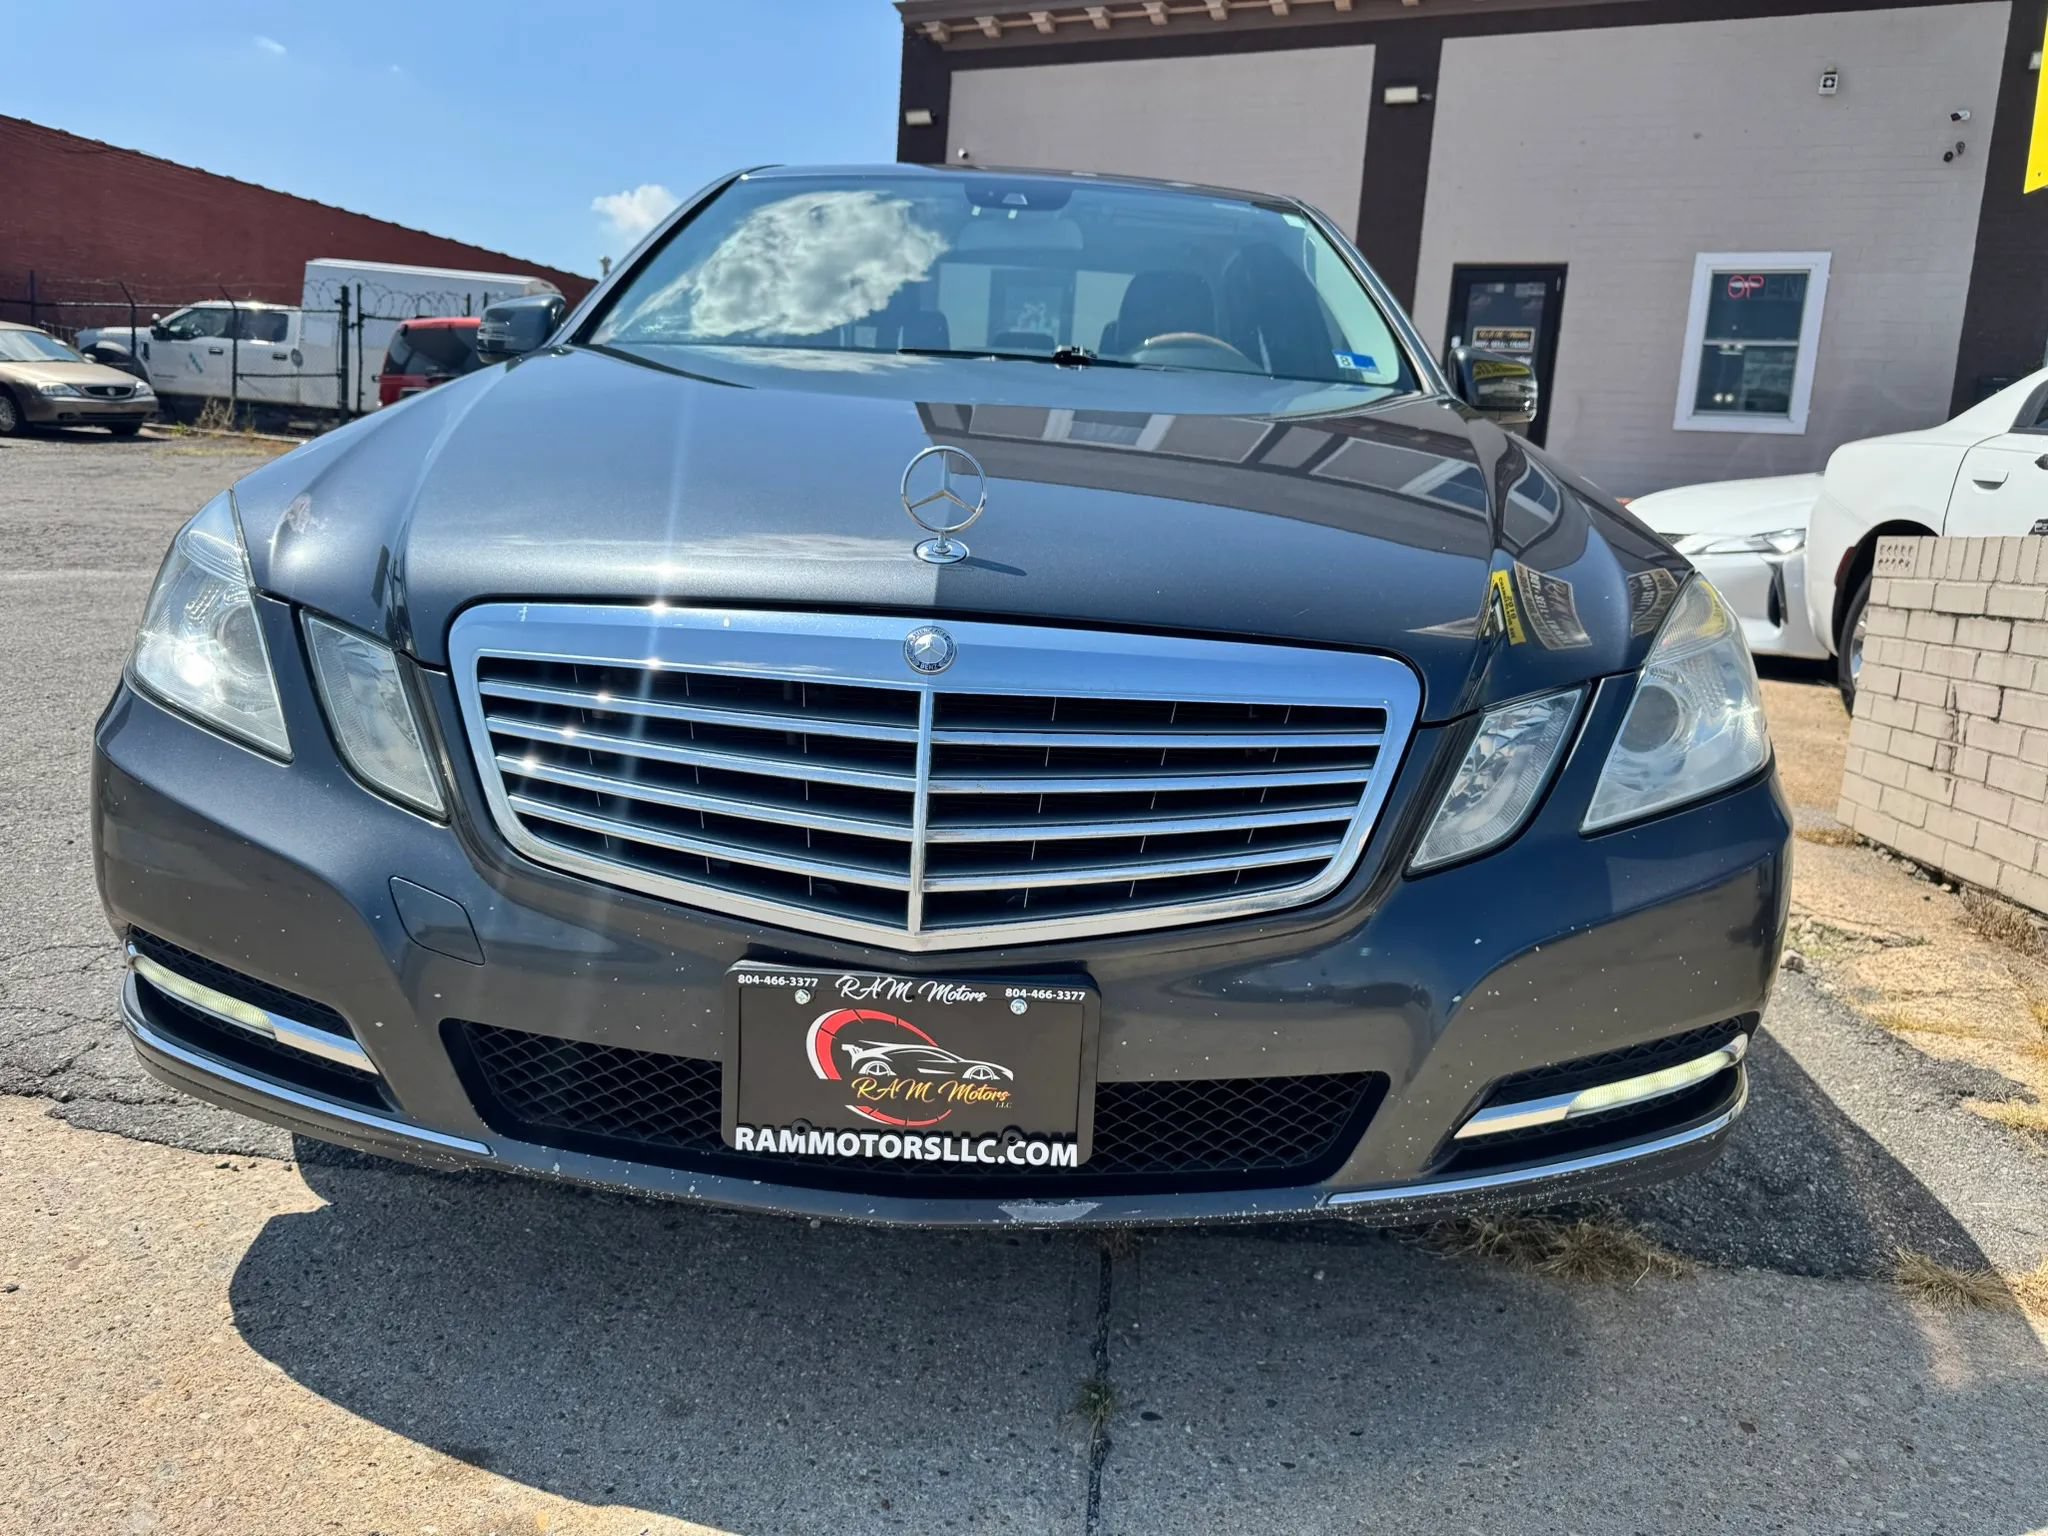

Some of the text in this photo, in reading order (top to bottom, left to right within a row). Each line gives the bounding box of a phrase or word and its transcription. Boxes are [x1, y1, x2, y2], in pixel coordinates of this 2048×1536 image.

[738, 974, 818, 987] 804-466-3377
[835, 975, 987, 1005] RAM Motors
[1005, 988, 1086, 1001] 804-466-3377
[851, 1077, 1011, 1105] RAM Motors
[735, 1126, 1078, 1167] RAMMOTORSLLC.COM
